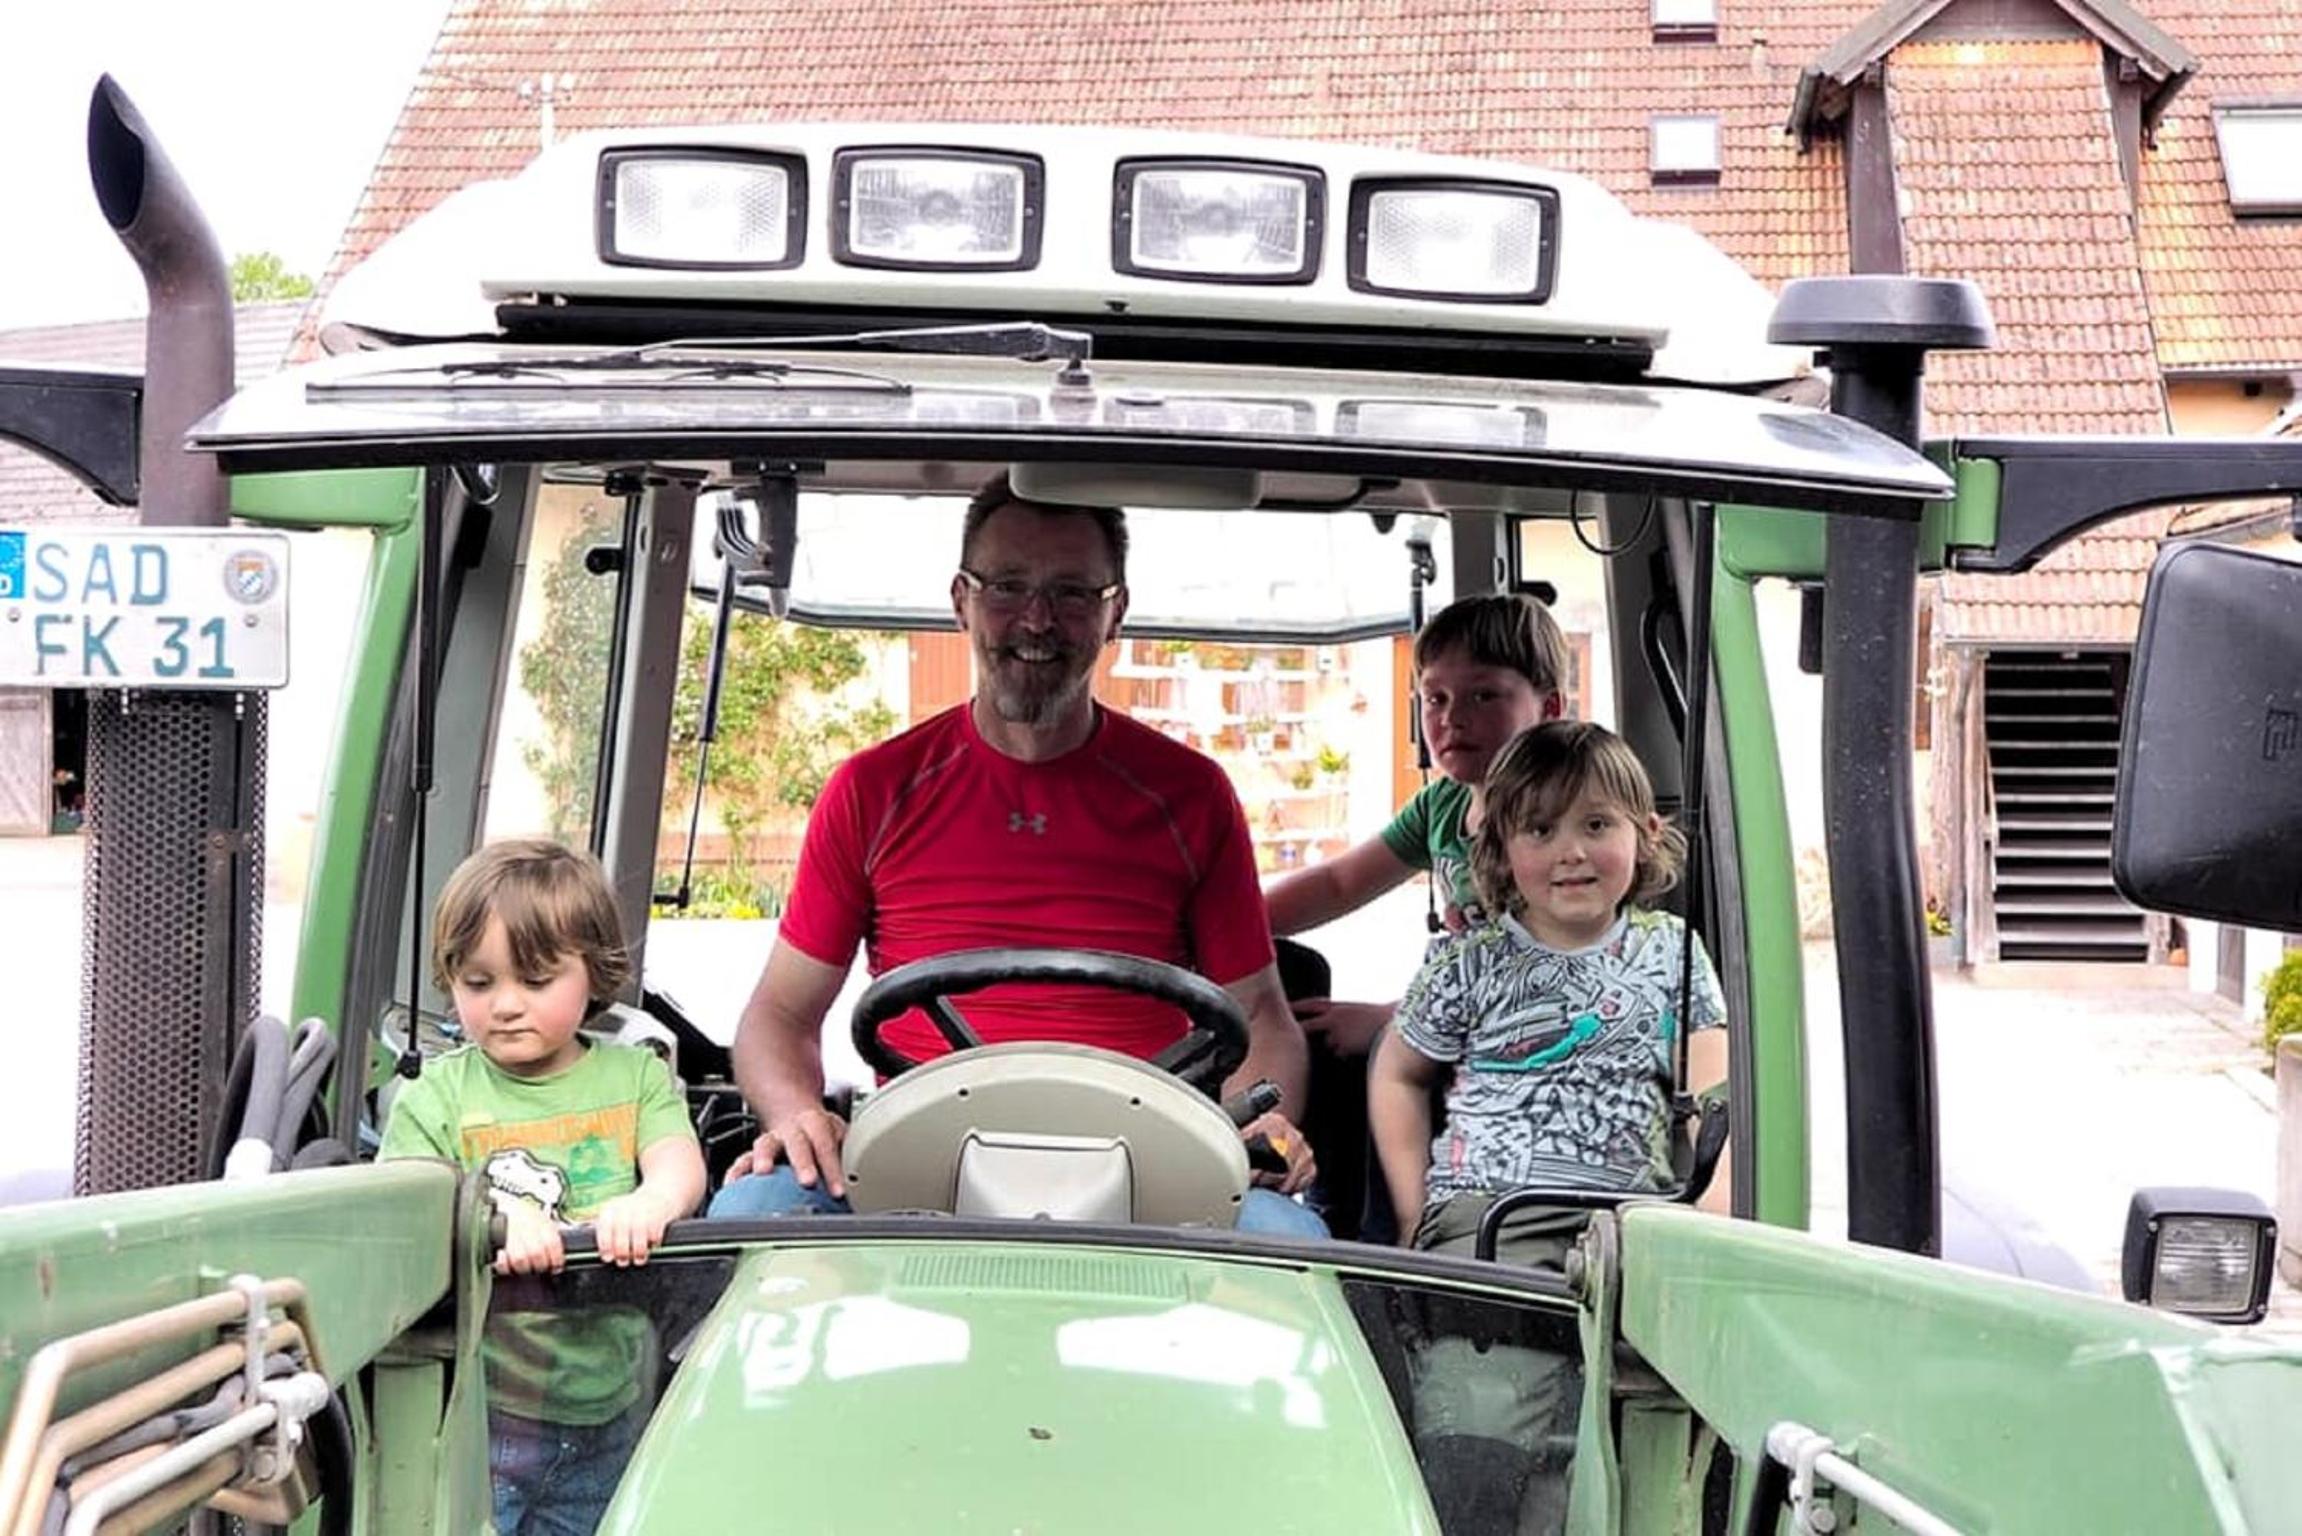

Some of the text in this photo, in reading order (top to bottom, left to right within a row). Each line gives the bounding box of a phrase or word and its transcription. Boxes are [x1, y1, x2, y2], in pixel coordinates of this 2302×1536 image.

[33, 542, 169, 605] SAD
[34, 614, 236, 679] FK 31
